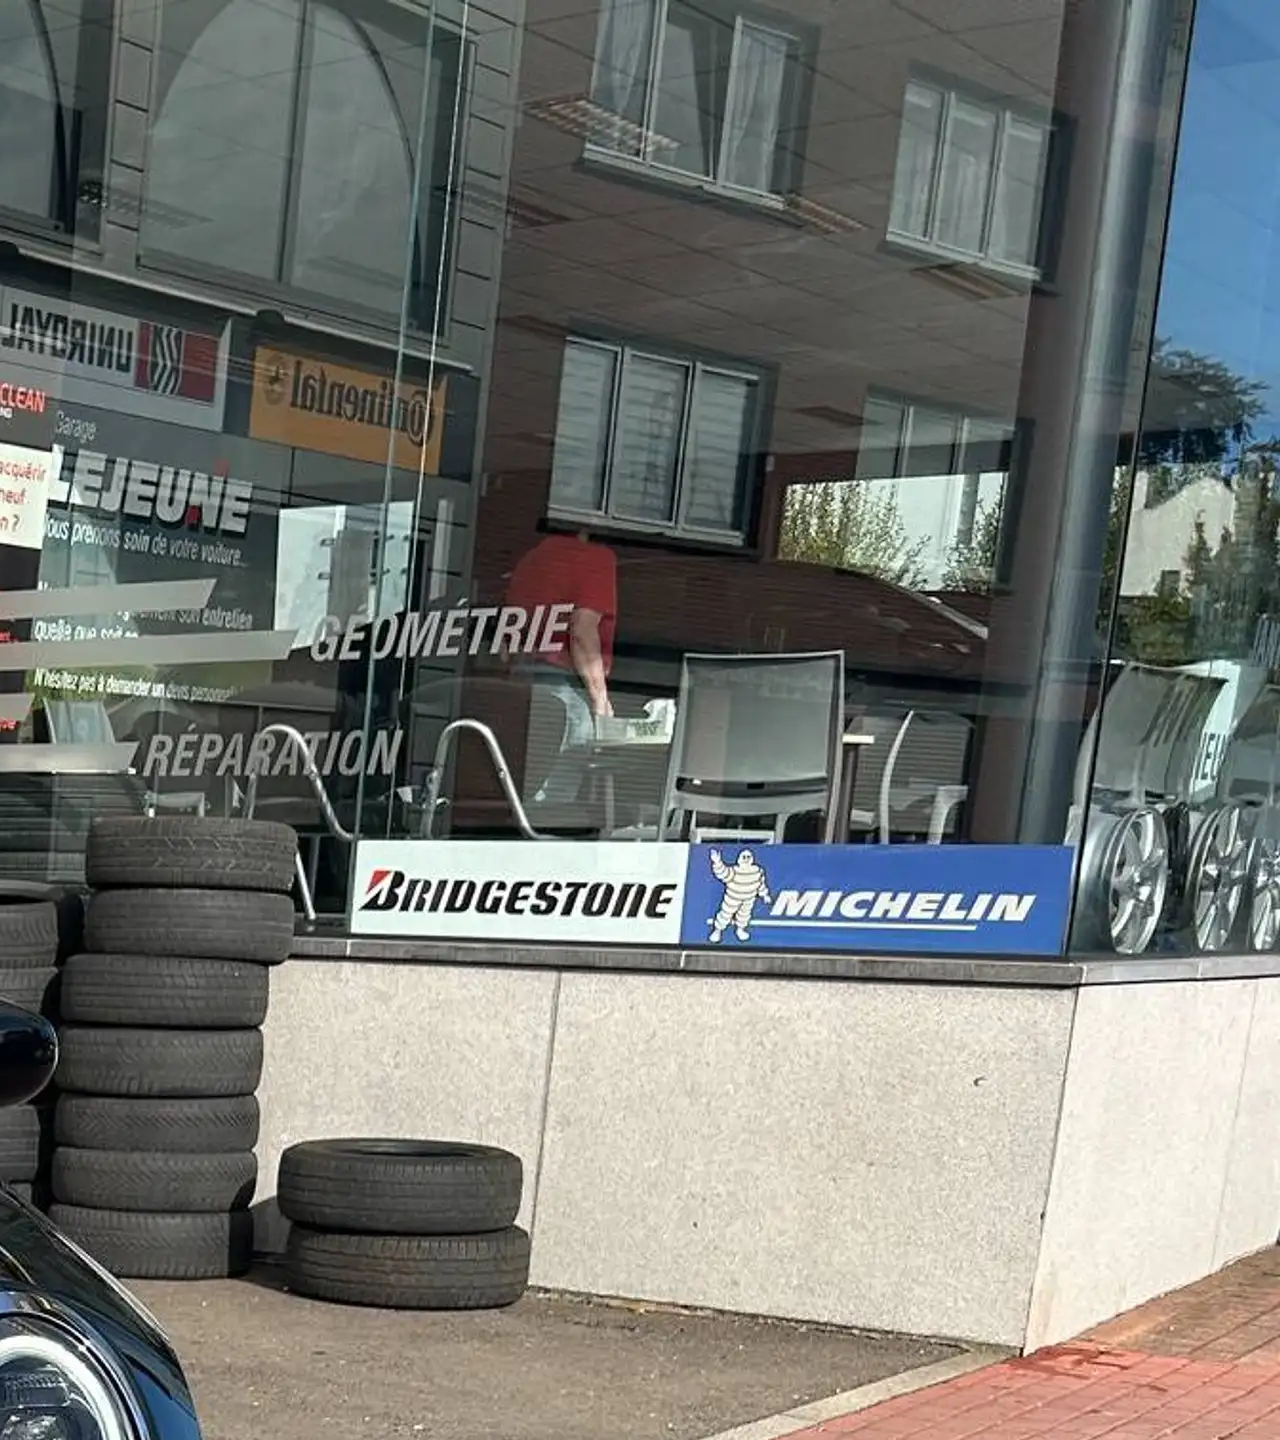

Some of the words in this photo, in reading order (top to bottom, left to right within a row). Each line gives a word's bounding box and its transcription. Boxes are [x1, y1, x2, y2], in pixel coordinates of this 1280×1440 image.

[47, 443, 253, 533] LEJEUNE
[124, 529, 149, 552] soin
[152, 533, 167, 556] de
[309, 598, 575, 662] GÉOMÉTRIE
[143, 723, 405, 777] RÉPARATION
[359, 868, 678, 920] BRIDGESTONE
[770, 887, 1037, 923] MICHELIN
